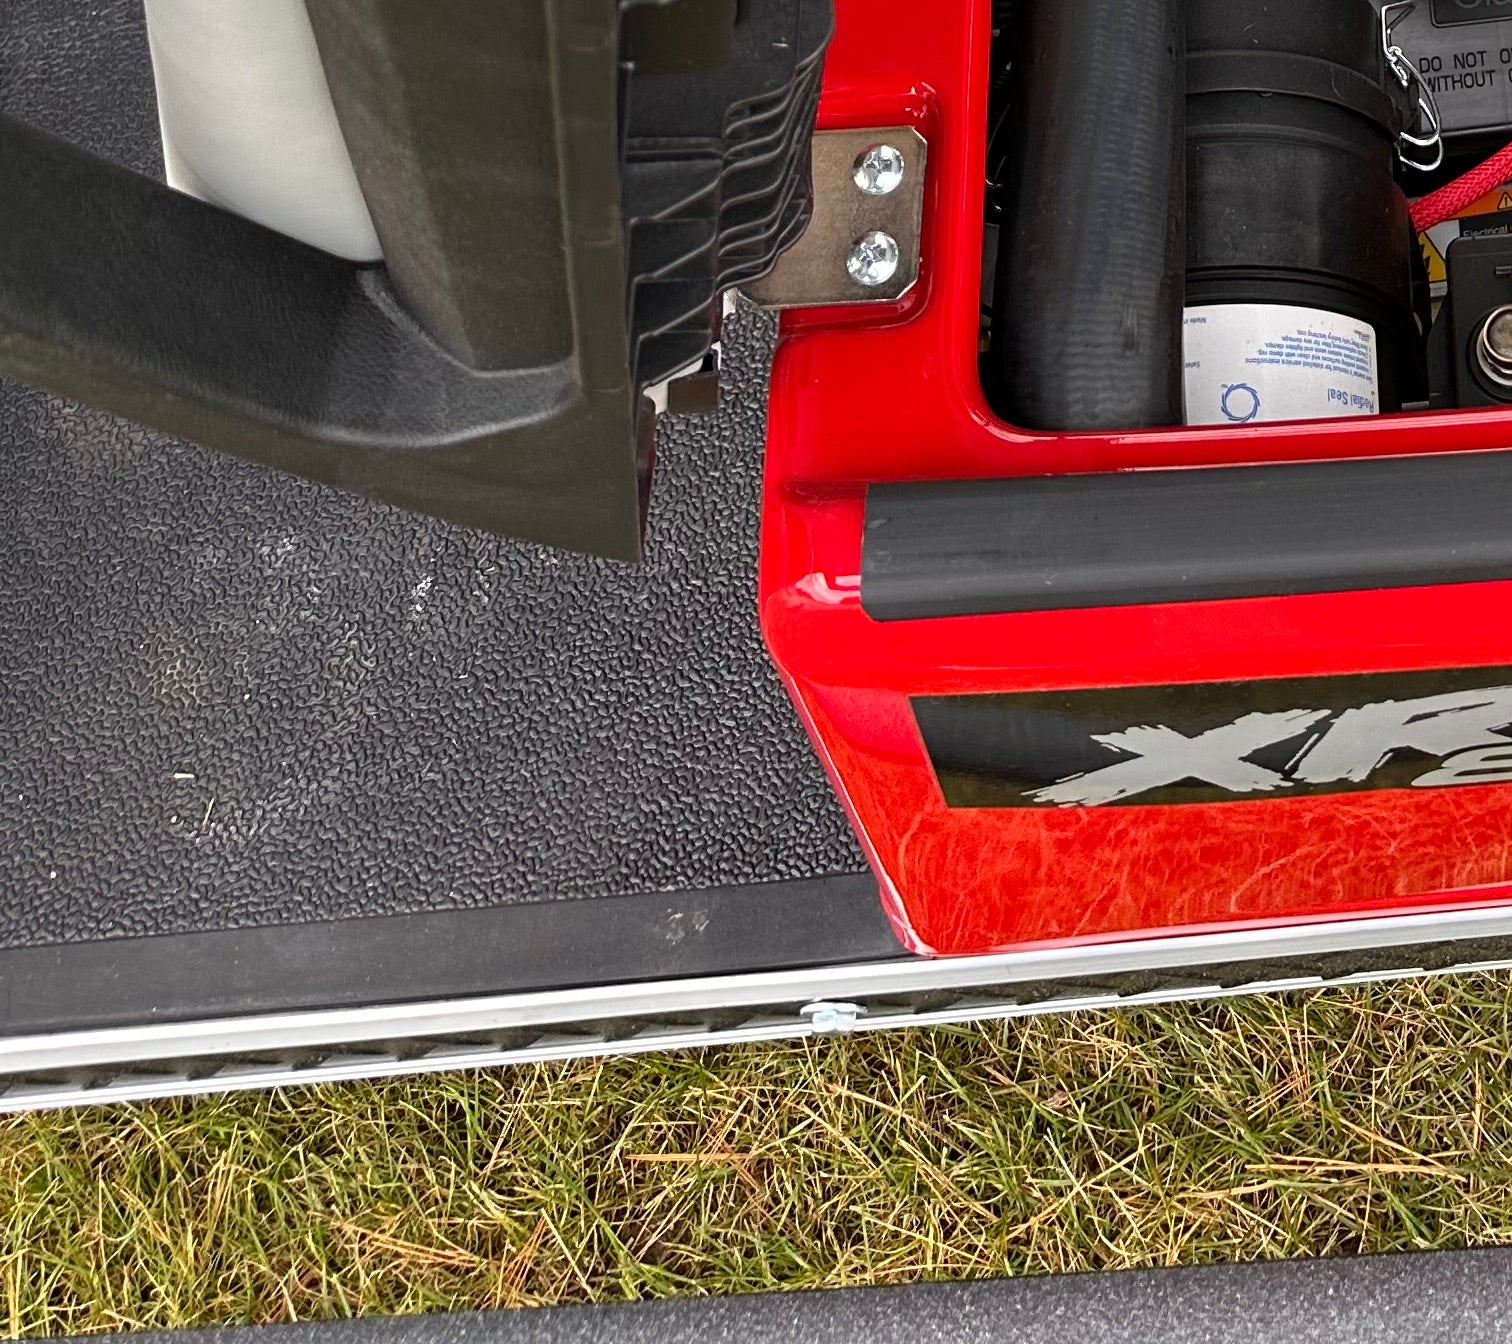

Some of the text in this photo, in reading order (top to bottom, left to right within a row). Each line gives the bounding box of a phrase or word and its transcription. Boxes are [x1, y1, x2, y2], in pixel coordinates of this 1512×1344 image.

[1418, 56, 1443, 75] DO
[1453, 49, 1488, 71] NOT
[1422, 69, 1497, 94] WITHOUT
[1327, 388, 1375, 412] Radial Seal
